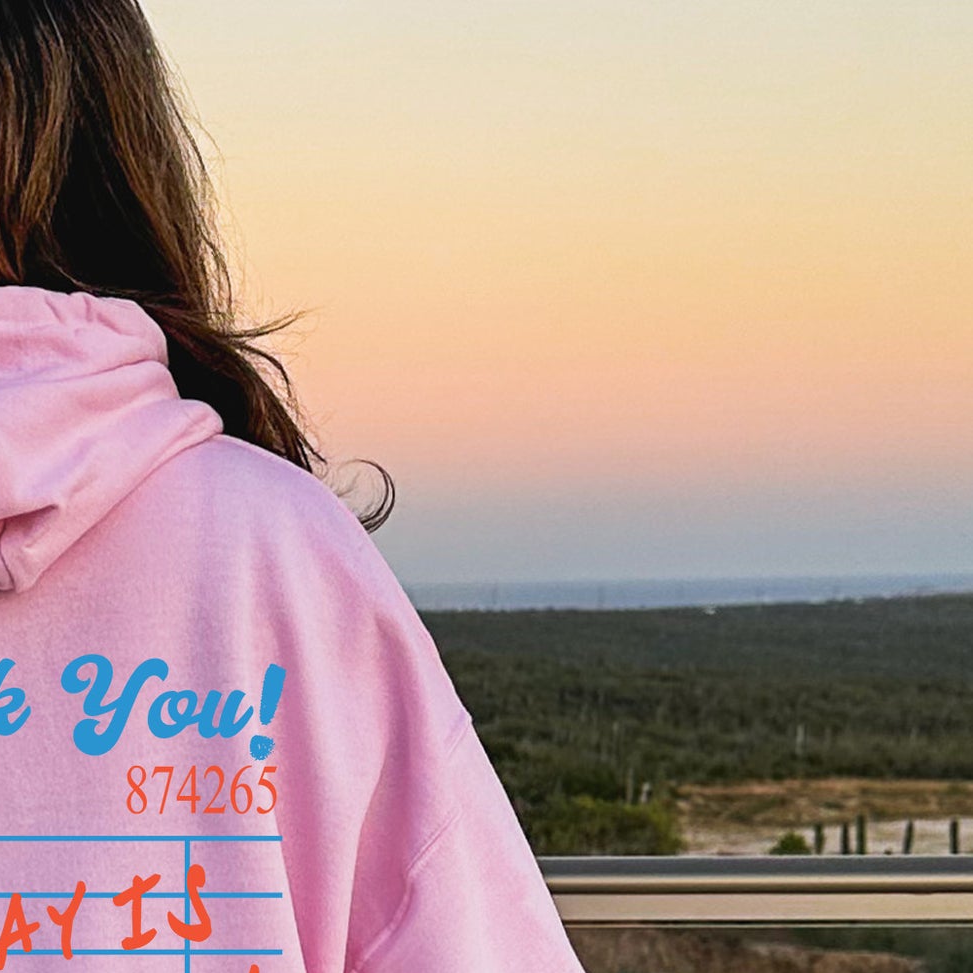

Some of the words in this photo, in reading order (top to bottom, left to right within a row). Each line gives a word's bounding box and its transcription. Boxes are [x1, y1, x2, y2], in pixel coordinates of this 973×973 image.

[60, 653, 287, 761] You!
[126, 765, 278, 815] 874265
[112, 863, 213, 951] IS
